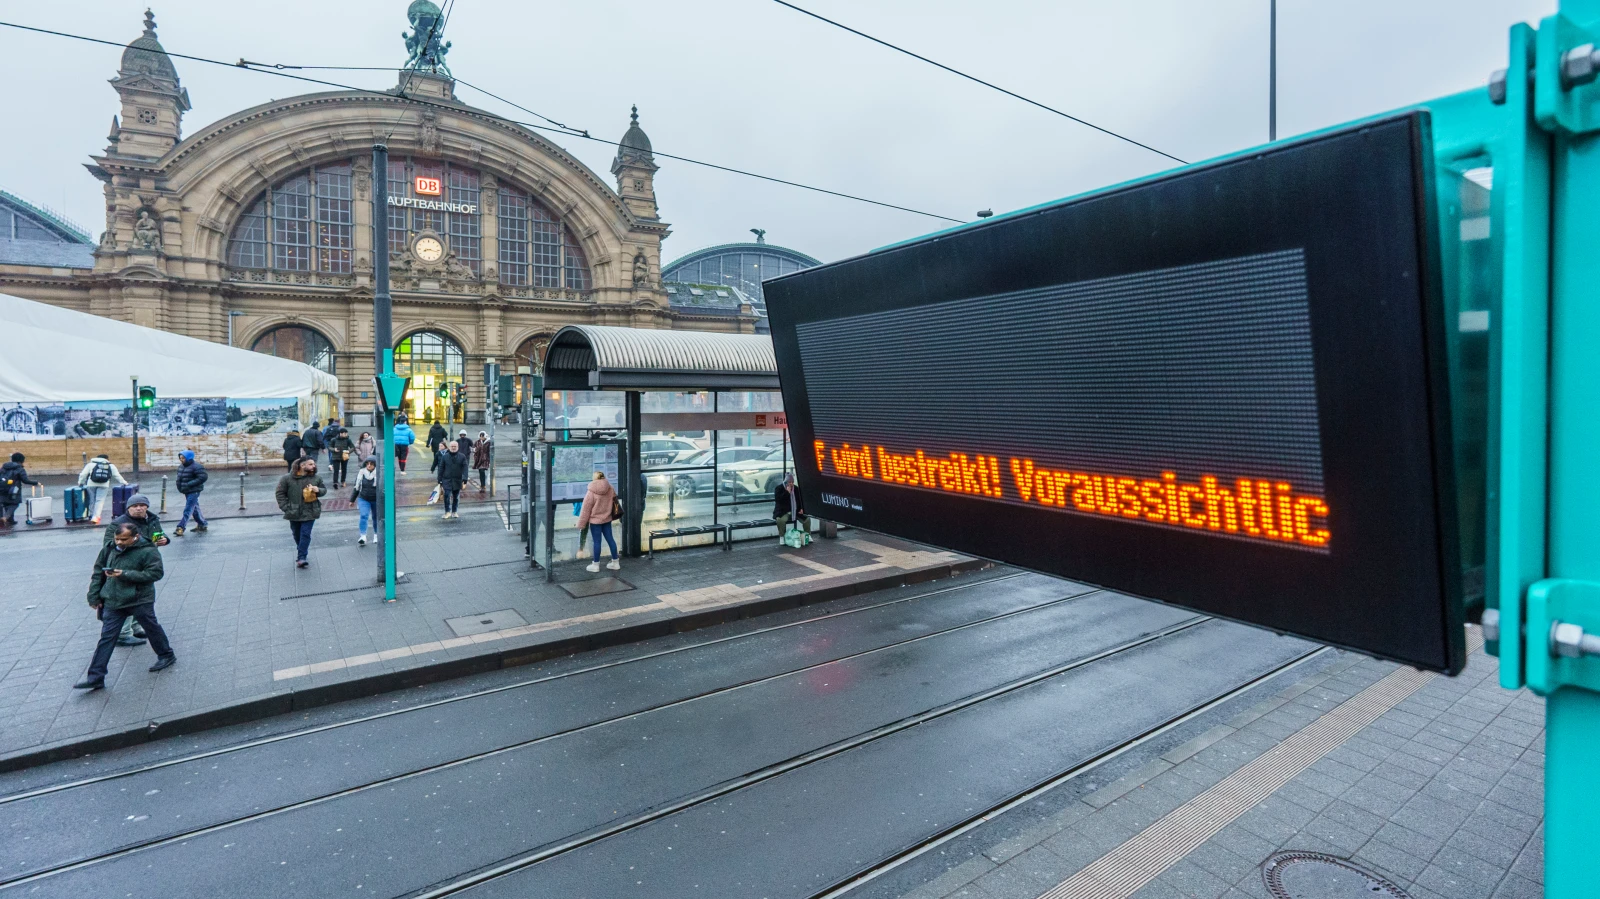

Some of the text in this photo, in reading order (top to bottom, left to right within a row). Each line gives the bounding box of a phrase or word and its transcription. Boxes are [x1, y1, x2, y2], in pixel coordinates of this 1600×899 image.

[419, 179, 437, 191] DB
[387, 195, 477, 214] AUPTBAHNHOF
[814, 440, 1331, 546] F wird bestreikt! Voraussichtlic
[821, 492, 849, 508] LUMINO
